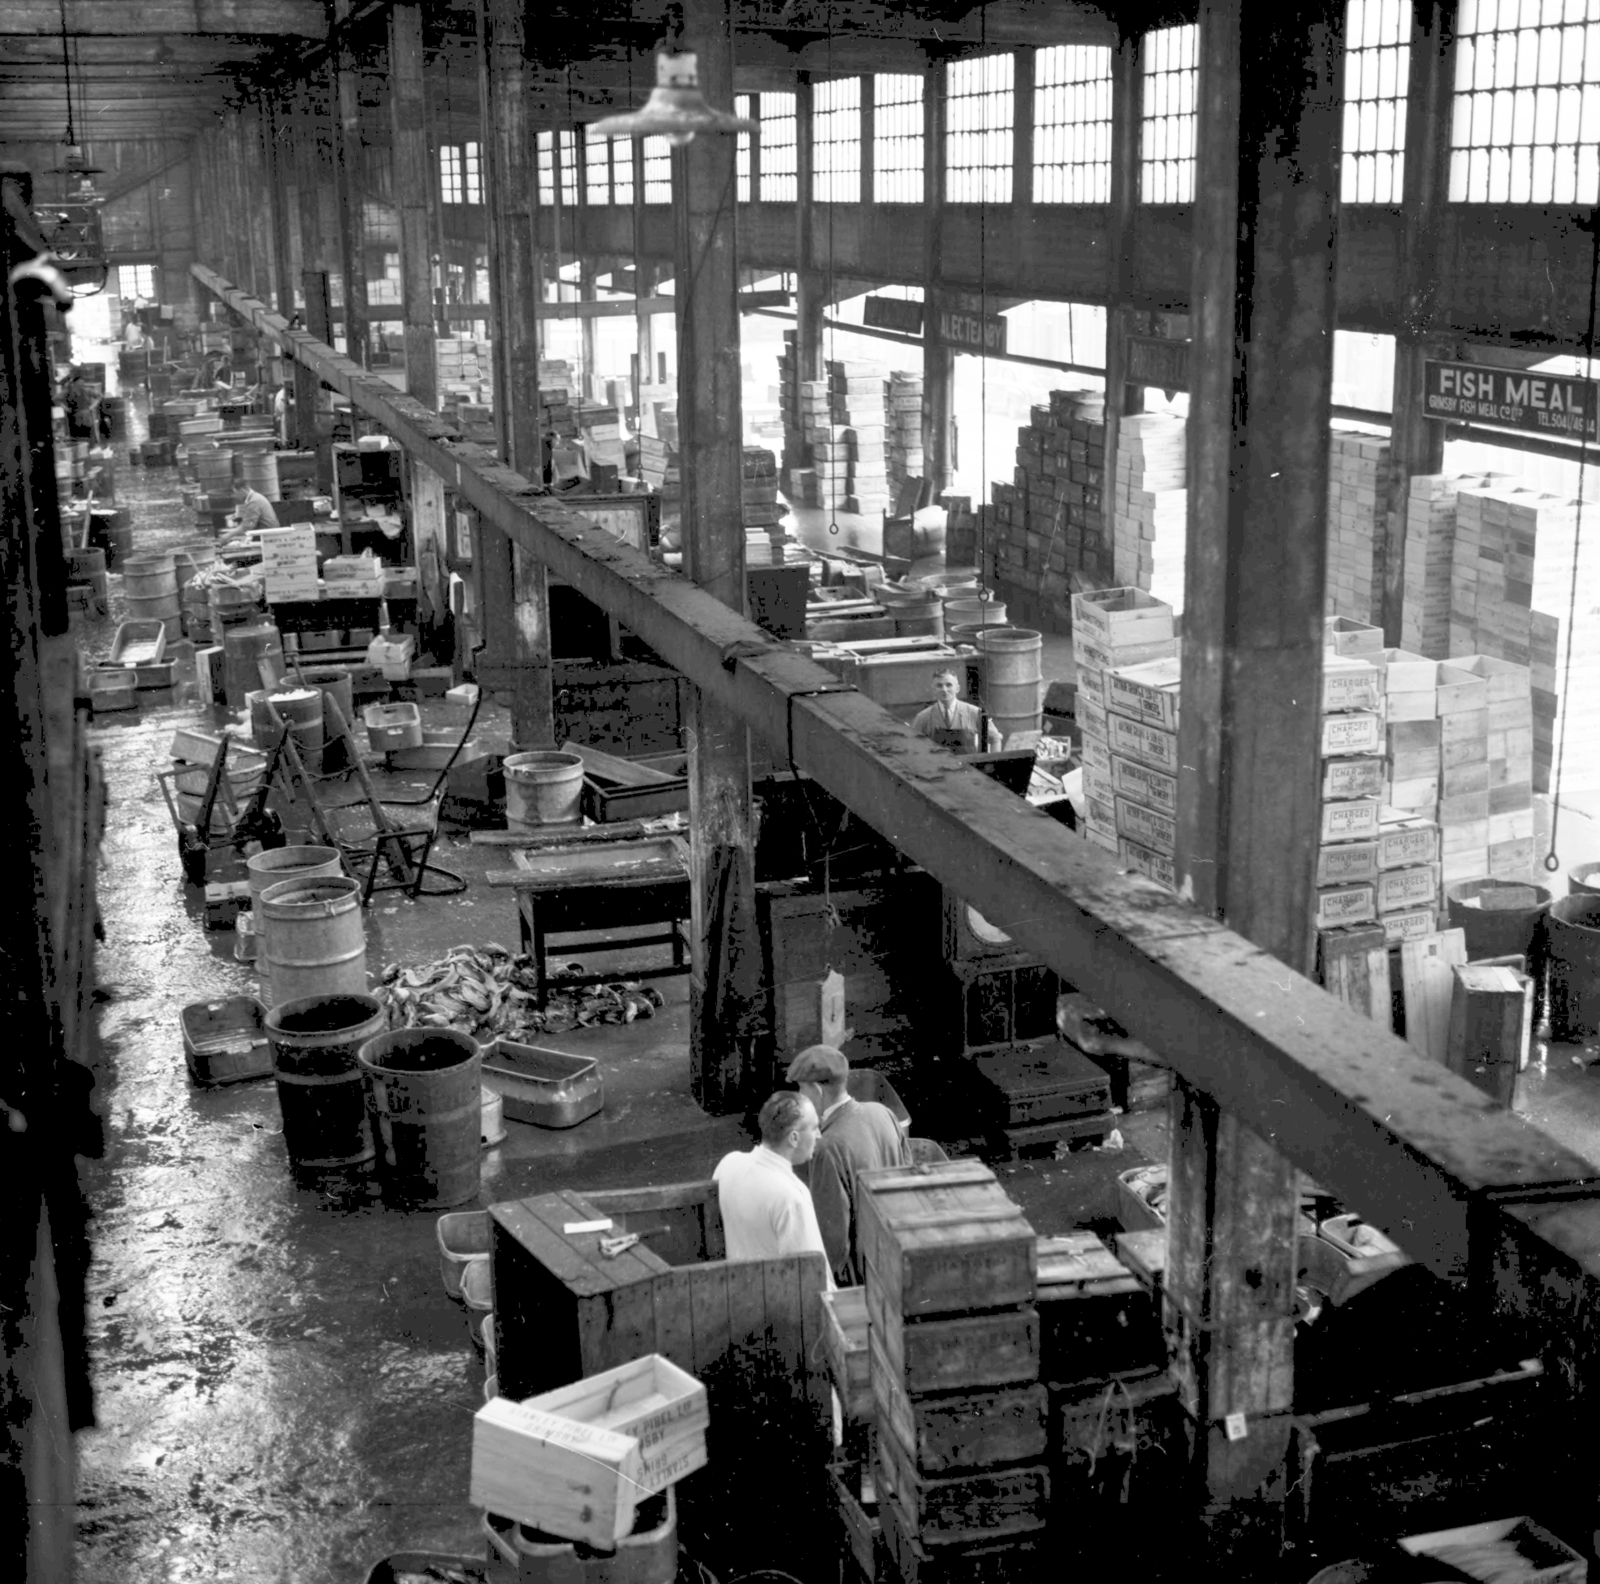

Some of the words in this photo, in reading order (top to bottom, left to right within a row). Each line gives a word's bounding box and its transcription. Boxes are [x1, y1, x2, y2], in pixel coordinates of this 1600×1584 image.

[1439, 368, 1494, 401] FISH
[1505, 376, 1583, 414] MEAL
[1460, 398, 1476, 414] FISH
[1478, 402, 1498, 418] MEAL
[1331, 678, 1370, 689] CHARGED
[1331, 722, 1368, 734] CHARGED
[1335, 767, 1374, 778] CHARGED
[1333, 809, 1370, 820] CHARGED
[1388, 834, 1425, 848] CHARGED
[1329, 852, 1368, 864] CHARGED
[1388, 875, 1425, 889] CHARGED
[1326, 893, 1365, 906] CHARGED
[1388, 917, 1425, 931] CHARGED
[508, 1407, 557, 1426] STANLEY
[561, 1422, 594, 1439] PIBEL
[643, 1410, 674, 1433] PIBEL
[524, 1423, 577, 1443] GRIMSBY
[650, 1454, 689, 1488] STANLEY
